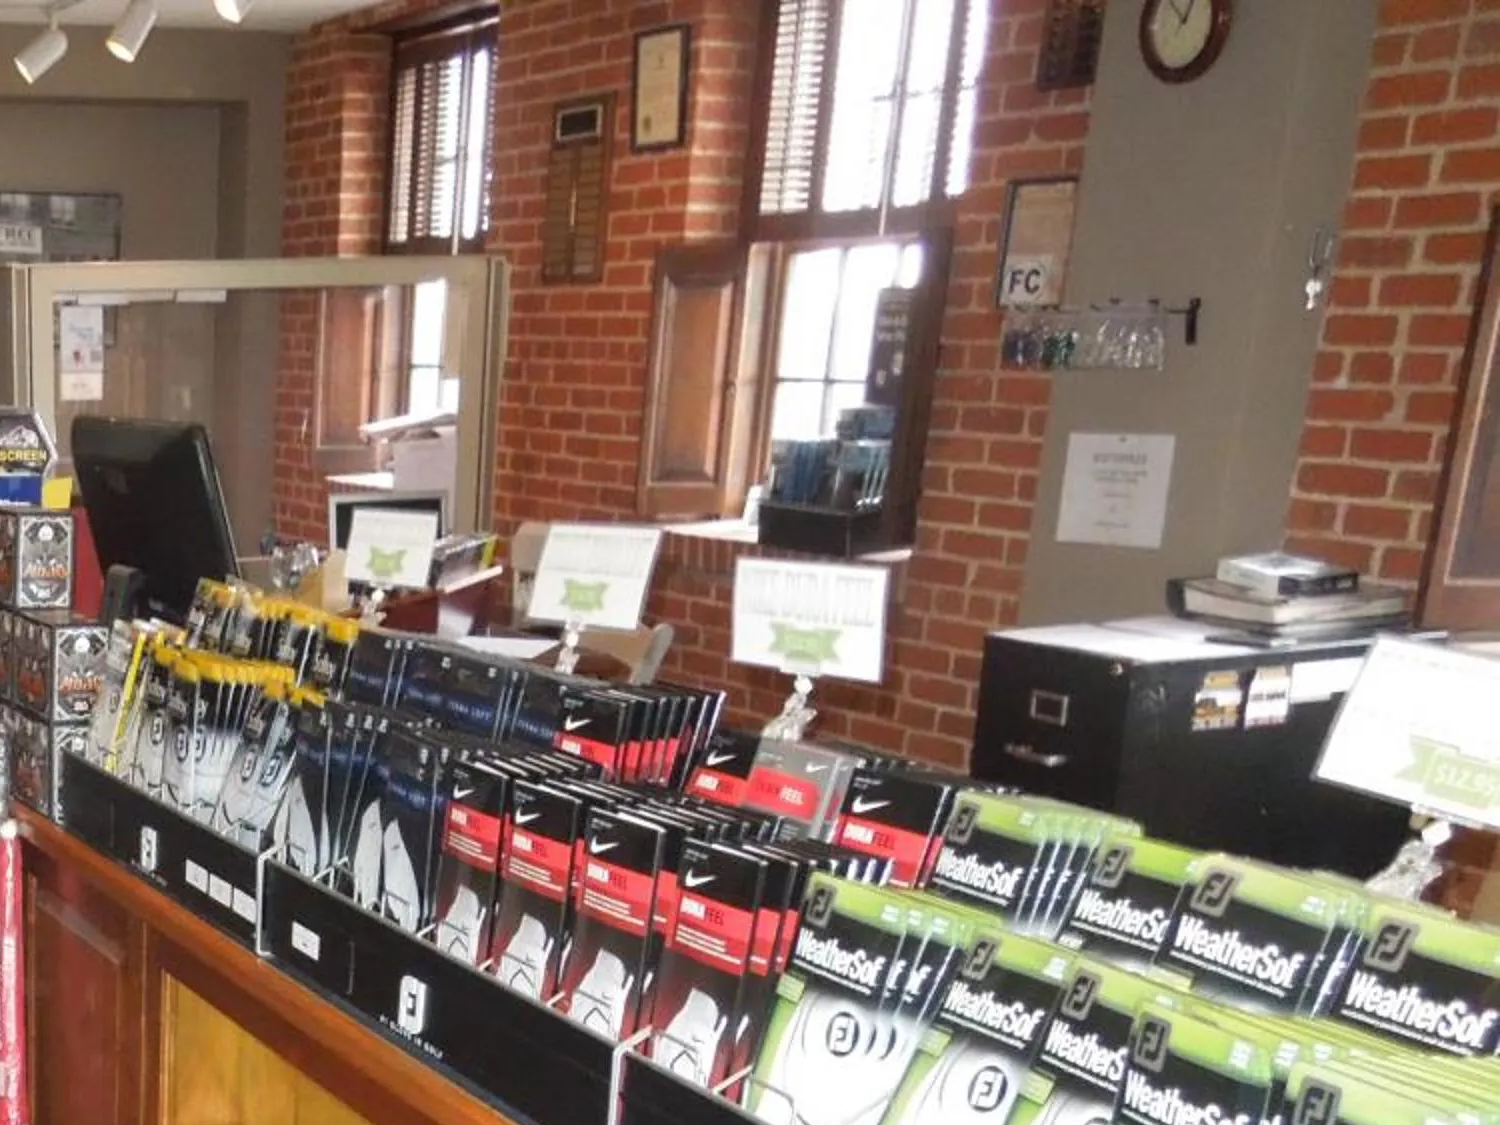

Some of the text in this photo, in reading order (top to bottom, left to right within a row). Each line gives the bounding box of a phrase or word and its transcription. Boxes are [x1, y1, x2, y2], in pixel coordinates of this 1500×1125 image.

[1008, 268, 1041, 295] FC
[936, 847, 1025, 898] WeatherSof
[1074, 889, 1171, 943] WeatherSo
[795, 928, 886, 987] WeatherSof
[1175, 913, 1306, 989] WeatherSof
[944, 979, 1045, 1041] WeatherSof
[1345, 969, 1500, 1049] WeatherSof
[1045, 1018, 1130, 1082] WeatherS
